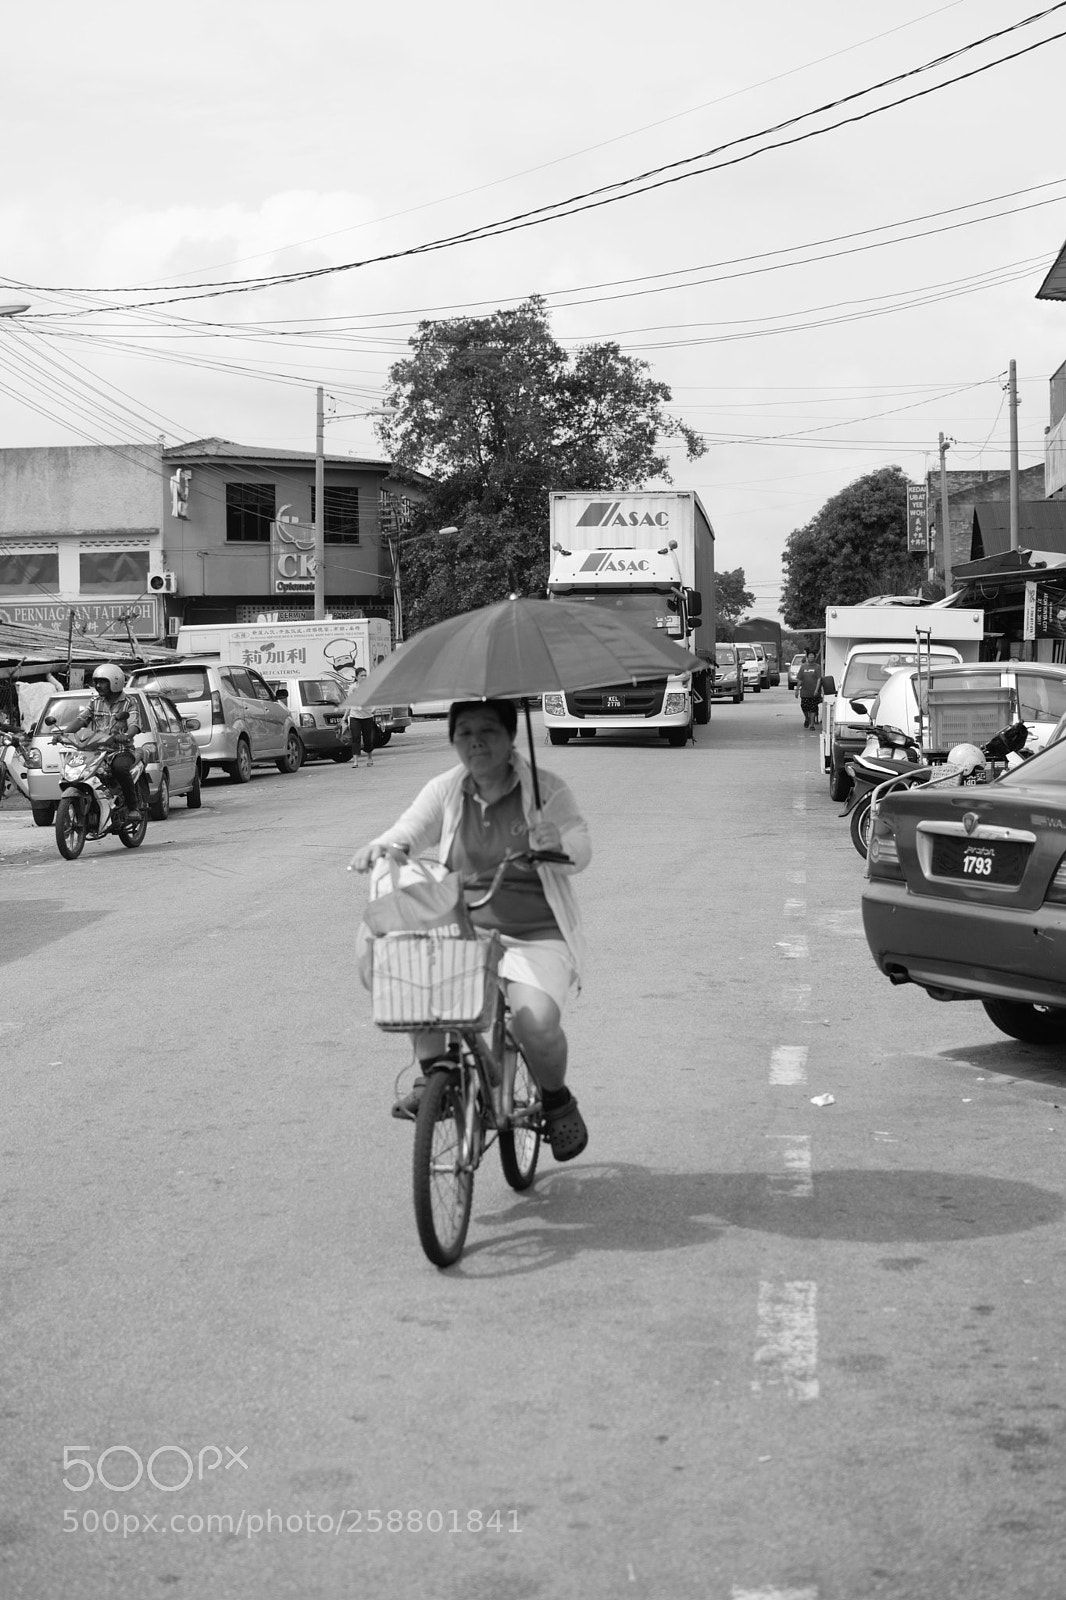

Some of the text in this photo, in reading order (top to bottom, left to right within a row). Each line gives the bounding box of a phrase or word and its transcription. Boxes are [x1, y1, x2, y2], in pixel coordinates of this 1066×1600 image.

[611, 511, 669, 527] ASAC
[277, 554, 316, 578] CK
[604, 560, 650, 572] ASAC
[963, 855, 993, 875] 1793
